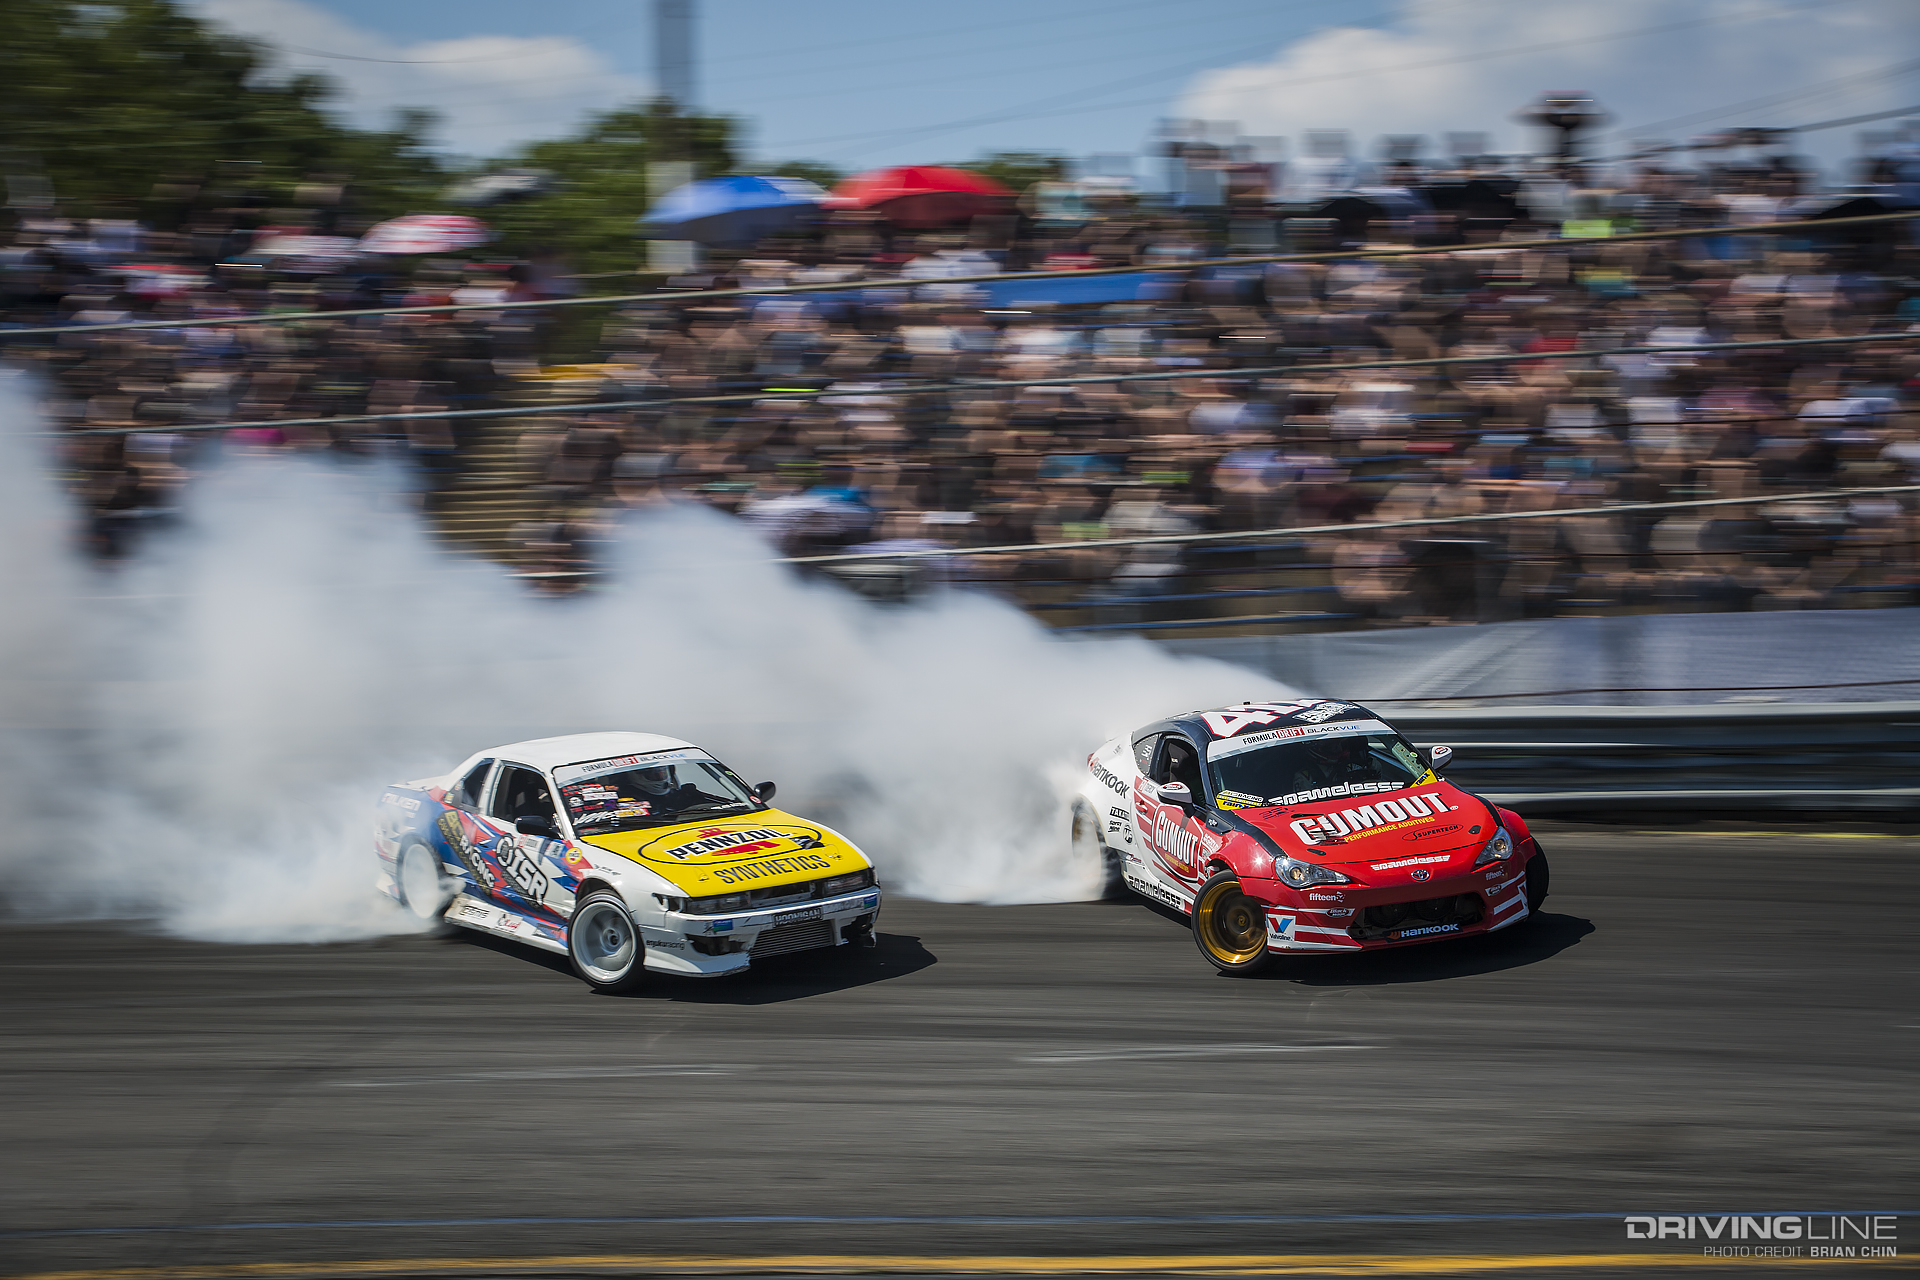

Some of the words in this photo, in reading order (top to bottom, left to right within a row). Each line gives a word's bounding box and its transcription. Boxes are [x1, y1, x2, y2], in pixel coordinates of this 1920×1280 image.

[1243, 732, 1278, 745] FORMULA
[1277, 727, 1305, 739] DRIFT
[1307, 725, 1361, 734] BLACKVUE
[582, 761, 613, 773] FORMULA
[1289, 792, 1451, 845] GUMOUT
[1344, 824, 1398, 843] PERFORMANCE
[1397, 816, 1435, 829] ADDITIVES
[1413, 824, 1460, 841] SUPERTECH
[664, 828, 793, 860] PENNZOIL
[1156, 810, 1199, 869] GUMOUT
[460, 834, 495, 888] RACING
[713, 854, 831, 884] SYNTHETICS
[506, 847, 548, 906] ISR
[1269, 933, 1292, 942] Valvoline
